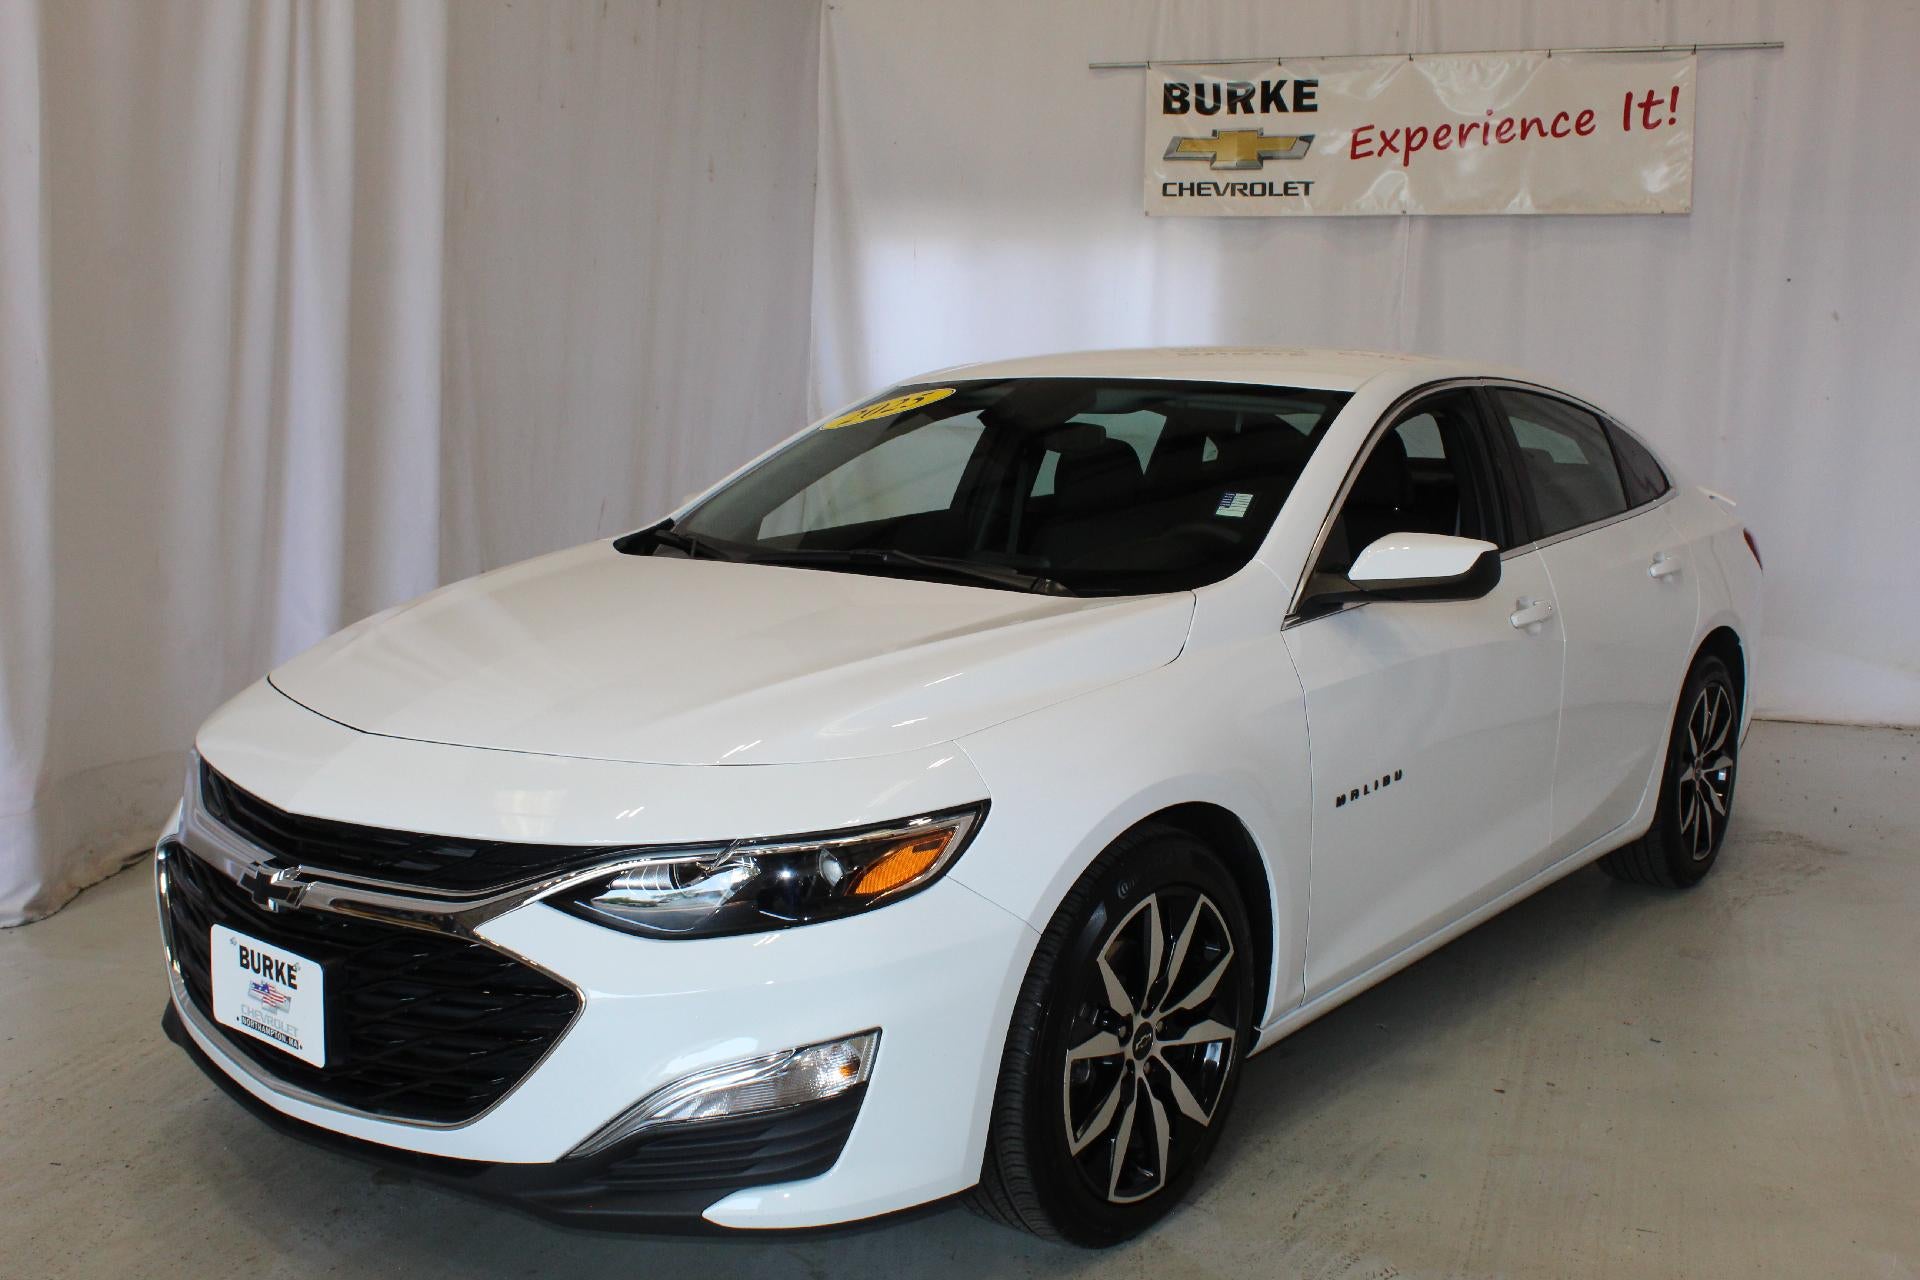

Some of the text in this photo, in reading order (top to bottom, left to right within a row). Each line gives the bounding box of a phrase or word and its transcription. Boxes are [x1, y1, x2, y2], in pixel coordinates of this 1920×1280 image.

[1162, 79, 1319, 115] BURKE
[1350, 85, 1681, 166] Experience It!
[1161, 181, 1315, 198] CHEVROLET
[1336, 769, 1402, 808] MALIBU
[239, 945, 298, 990] BURKE
[241, 1004, 298, 1037] CHEVROLET
